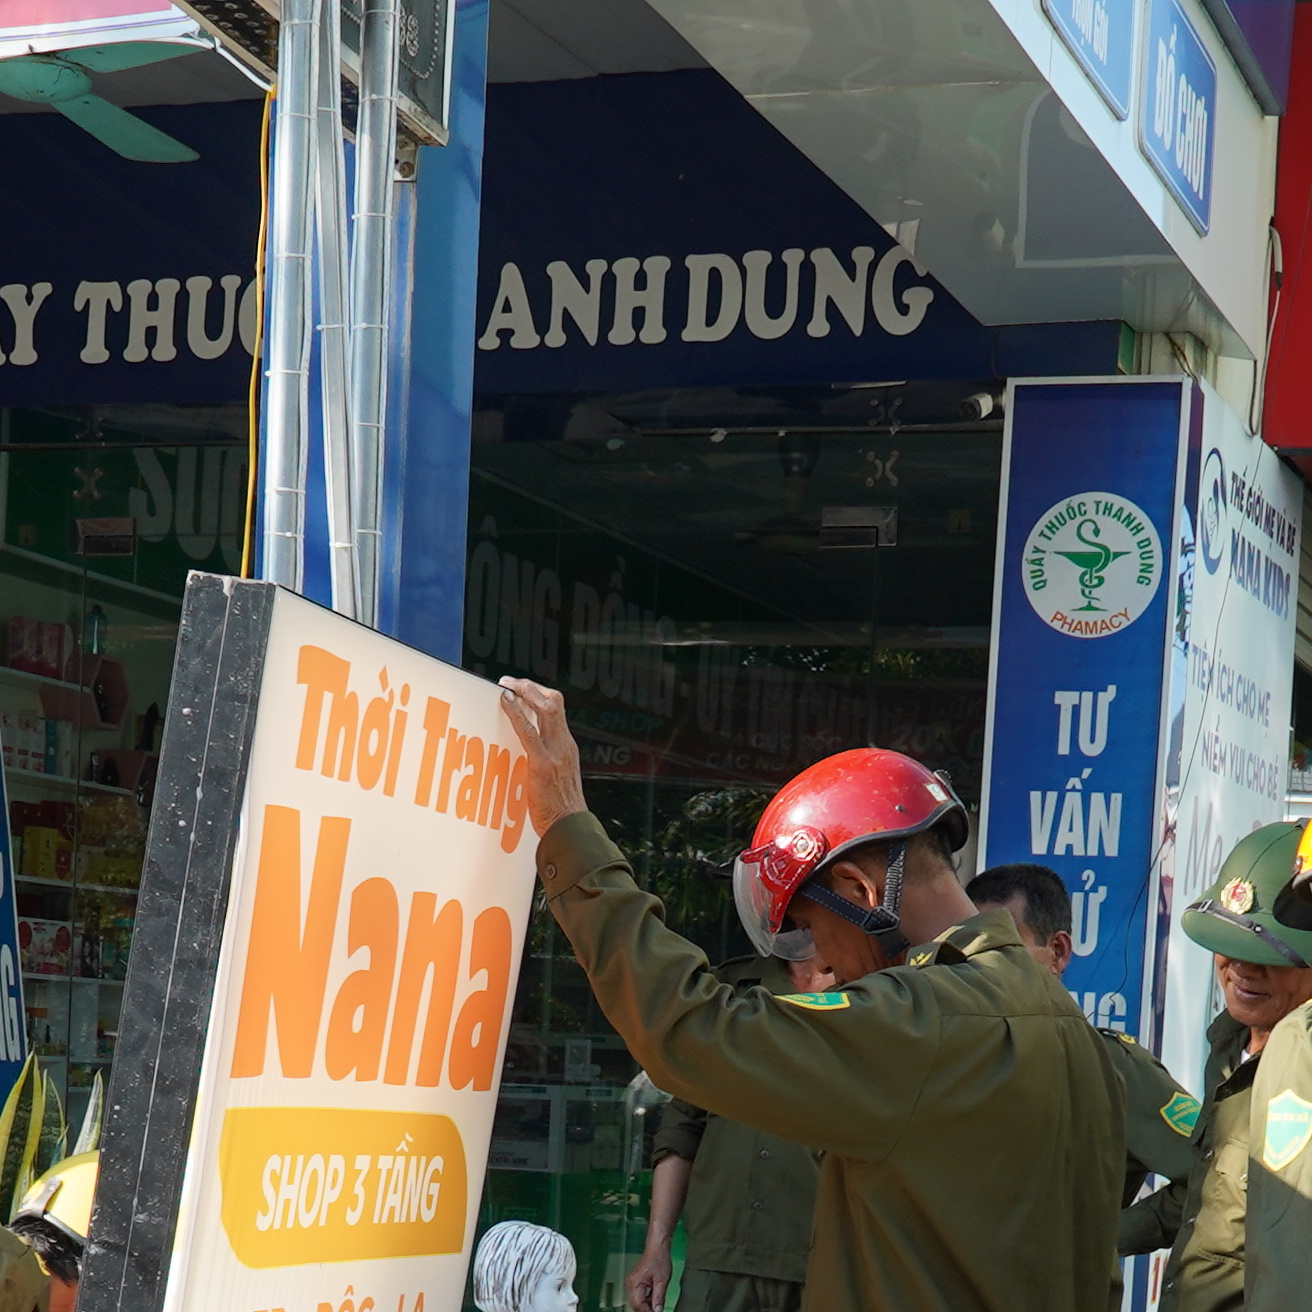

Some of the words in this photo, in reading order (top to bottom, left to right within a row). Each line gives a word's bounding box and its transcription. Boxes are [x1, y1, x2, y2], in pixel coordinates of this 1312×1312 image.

[1175, 73, 1208, 200] CHƠI
[73, 272, 264, 365] THU
[477, 256, 672, 350] ANH
[681, 245, 935, 343] DUNG
[1038, 499, 1087, 541] THUỐC
[1093, 500, 1145, 537] THANH
[1136, 537, 1154, 586] DUNG
[1231, 527, 1263, 602] NANA
[1263, 554, 1291, 622] KIDS
[466, 515, 562, 680] ỘNG
[1050, 607, 1131, 635] PHAMACY
[1054, 684, 1117, 757] TƯ
[1215, 649, 1235, 708] ÍCH
[1235, 673, 1257, 720] CHO
[295, 645, 411, 798] Thời
[414, 696, 531, 854] Trang
[1228, 743, 1246, 786] VUI
[1245, 751, 1267, 800] CHO
[1030, 767, 1123, 857] VẤN
[229, 804, 513, 1092] Nana
[1071, 869, 1108, 957] Ử
[256, 1153, 346, 1232] SHOP
[345, 1155, 372, 1226] 3
[372, 1131, 445, 1224] TẦNG
